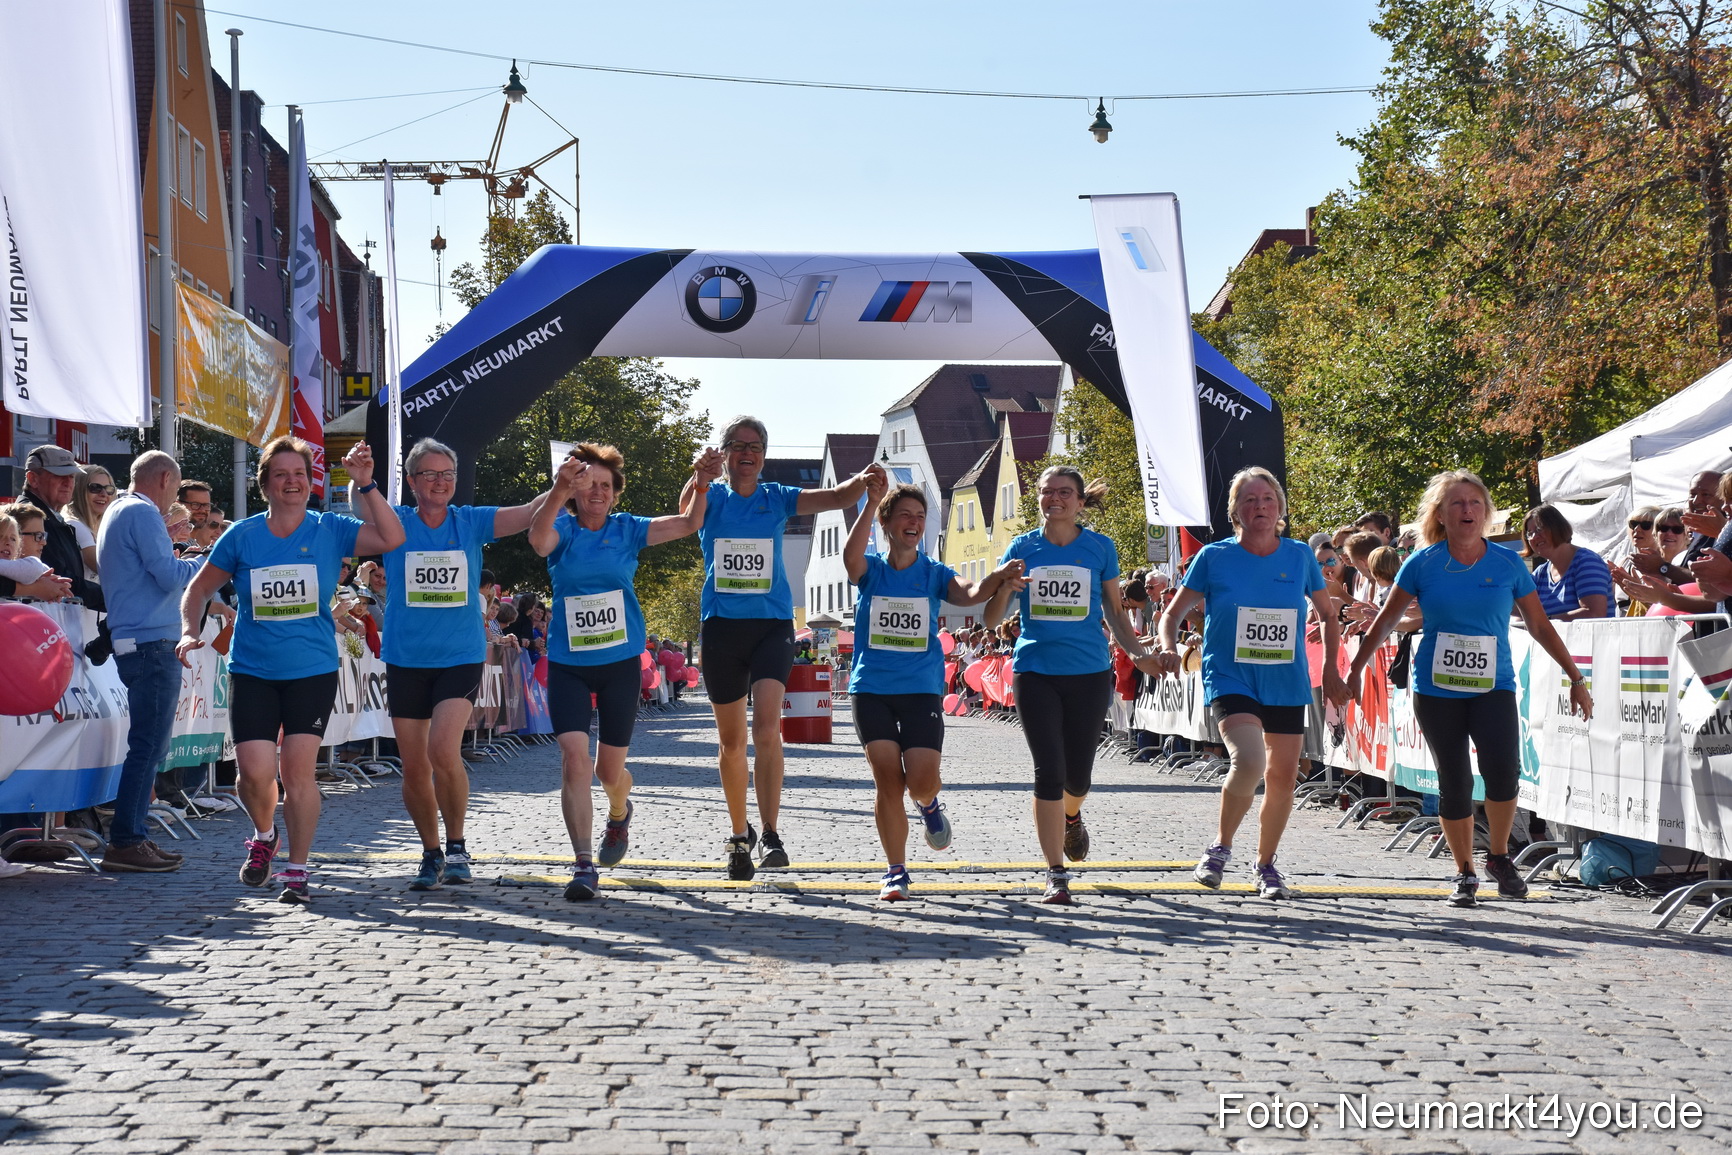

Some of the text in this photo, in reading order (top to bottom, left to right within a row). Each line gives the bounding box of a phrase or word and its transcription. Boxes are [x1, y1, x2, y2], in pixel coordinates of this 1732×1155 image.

[692, 264, 750, 287] BMW
[402, 378, 465, 419] PARTL
[462, 315, 564, 384] NEUMARKT
[723, 554, 764, 571] 5039
[415, 567, 459, 584] 5037
[261, 579, 306, 599] 5041
[728, 580, 759, 589] Angelika
[1038, 580, 1081, 598] 5042
[272, 606, 300, 615] Christa
[575, 607, 617, 628] 5040
[1046, 607, 1072, 615] Monika
[879, 612, 921, 630] 5036
[583, 633, 614, 644] Gertraud
[1246, 623, 1288, 641] 5038
[883, 637, 915, 646] Christine
[1249, 650, 1282, 659] Marianne
[1442, 649, 1488, 669] 5035
[1448, 676, 1479, 687] Barbara
